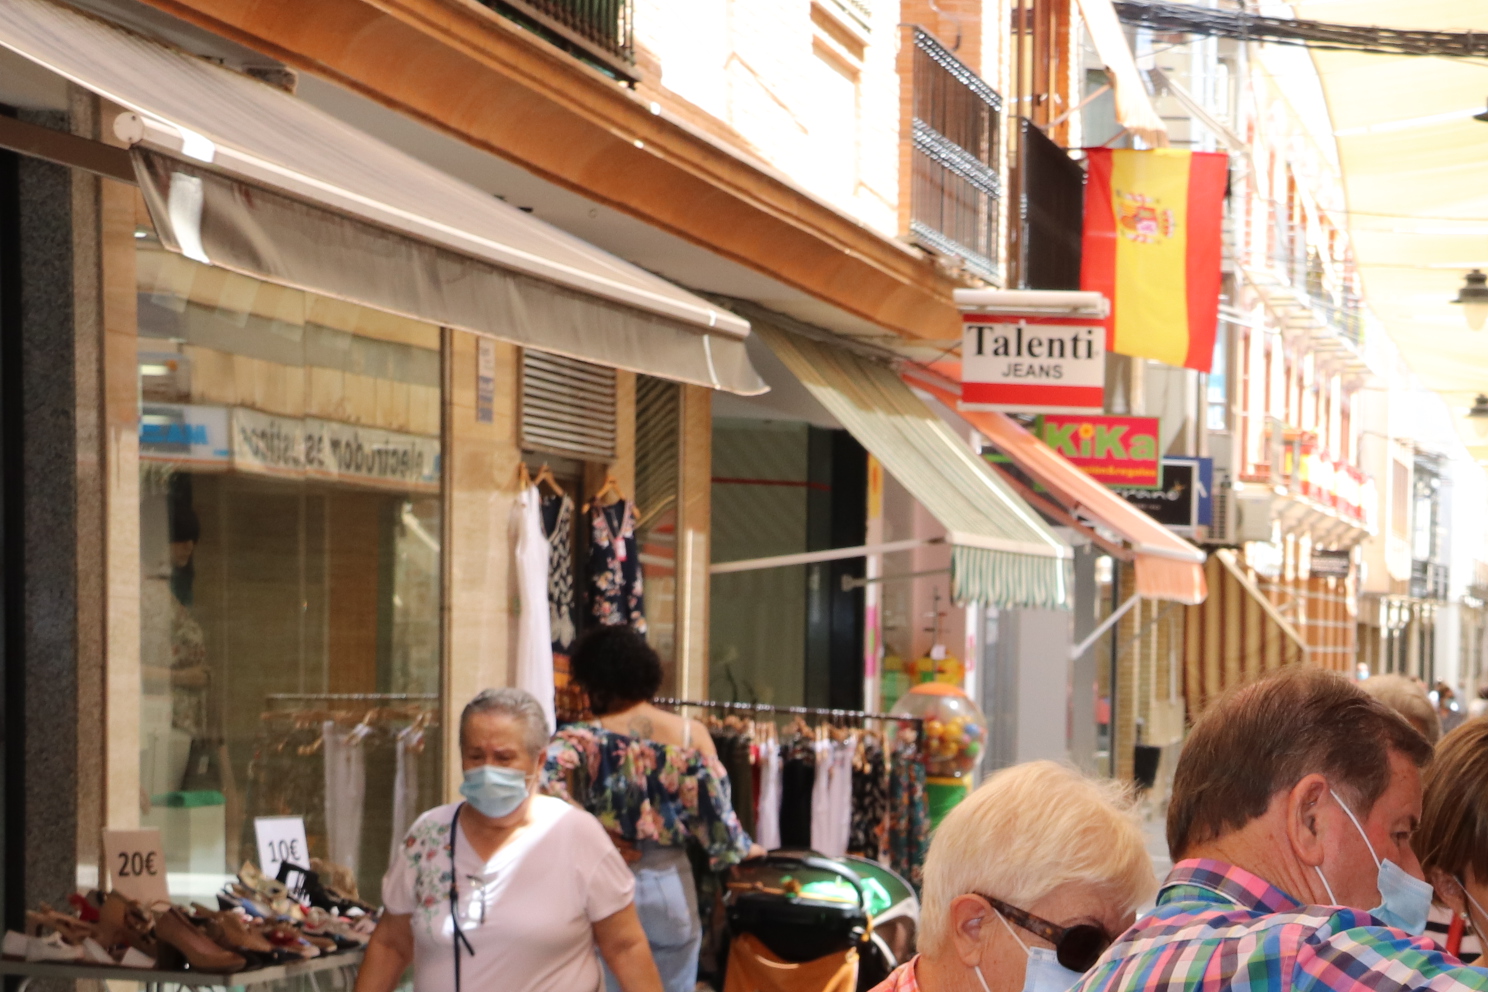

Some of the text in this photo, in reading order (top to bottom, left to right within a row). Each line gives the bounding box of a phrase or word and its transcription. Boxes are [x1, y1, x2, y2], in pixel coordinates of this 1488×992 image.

[967, 325, 1093, 359] Talenti
[1002, 362, 1063, 379] JEANS
[1046, 422, 1156, 461] KiKa
[268, 839, 300, 863] 10€
[118, 852, 157, 876] 20€
